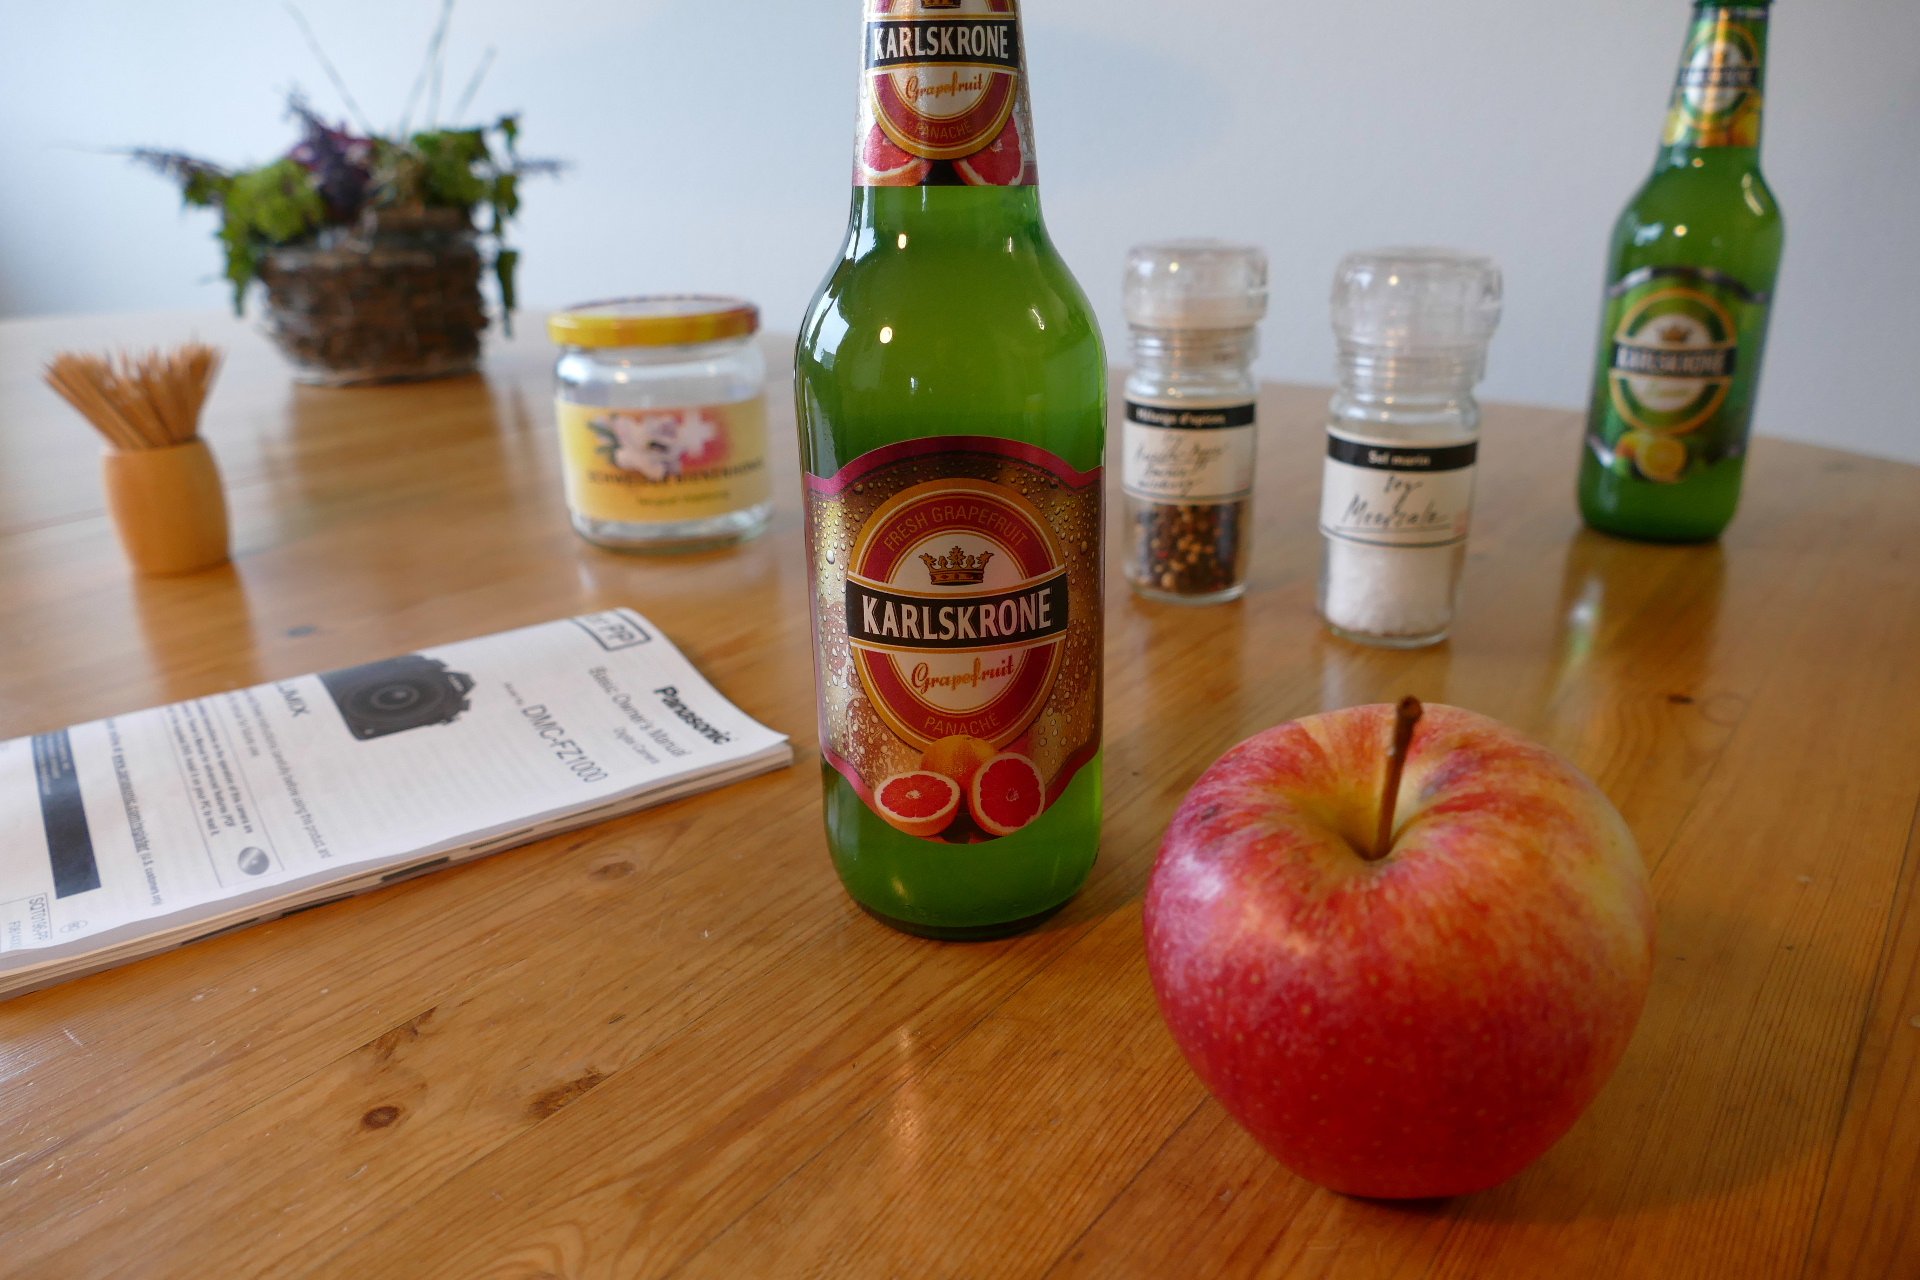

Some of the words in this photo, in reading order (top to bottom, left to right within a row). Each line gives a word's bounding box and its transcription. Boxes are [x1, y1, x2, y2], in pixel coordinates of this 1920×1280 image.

[873, 25, 1009, 60] KARLSKRONE
[905, 73, 983, 101] Grapefruit
[883, 514, 928, 552] FRESH
[932, 504, 1029, 548] GRAPEFRUIT
[861, 588, 1053, 641] KARLSKRONE
[911, 655, 1015, 694] Grapefruit
[653, 685, 732, 746] Panasonic
[521, 704, 608, 783] DMC-FZ1000
